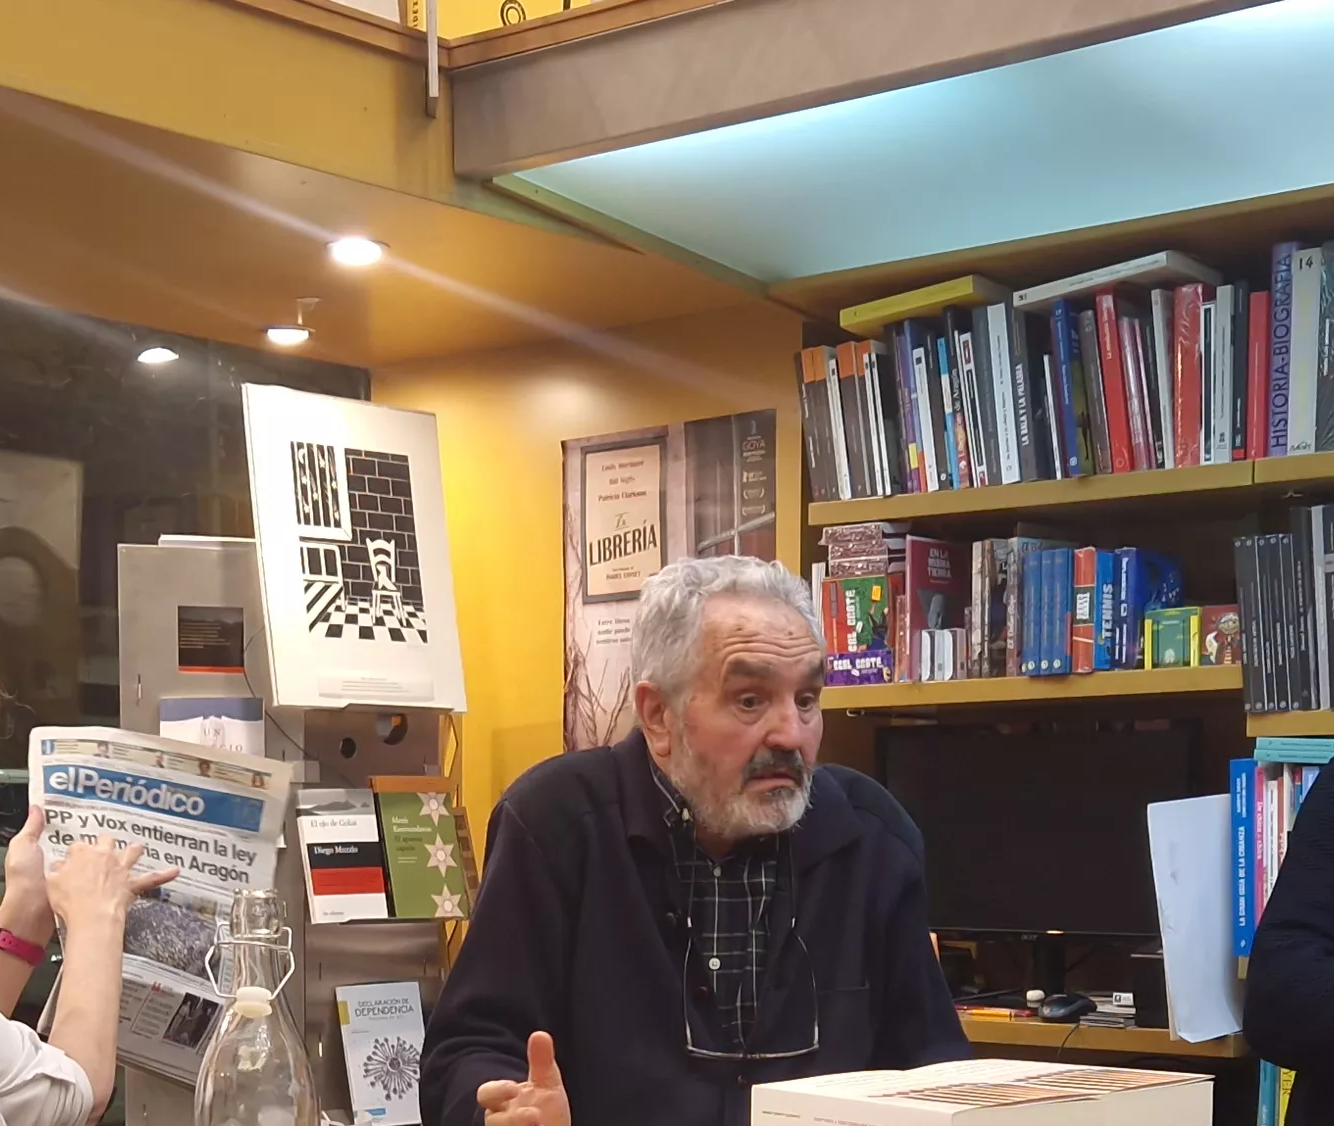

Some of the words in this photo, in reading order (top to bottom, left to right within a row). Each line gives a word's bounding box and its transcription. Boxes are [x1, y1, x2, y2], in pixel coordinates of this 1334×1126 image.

[1270, 255, 1291, 448] HISTORIA-BIOGRAFÍA
[1021, 435, 1030, 446] LA
[588, 520, 657, 566] LIBRERÍA
[1102, 583, 1113, 639] TENNIS
[45, 809, 72, 825] PP
[78, 814, 89, 828] y
[92, 814, 128, 832] Vox
[131, 822, 208, 853] entierran
[214, 839, 227, 859] la
[233, 842, 257, 866] ley
[48, 831, 75, 846] de
[80, 833, 161, 861] mmia
[164, 850, 185, 868] en
[189, 855, 250, 883] Aragón
[314, 846, 334, 856] Diego
[354, 1005, 415, 1018] DEPENDENCIA
